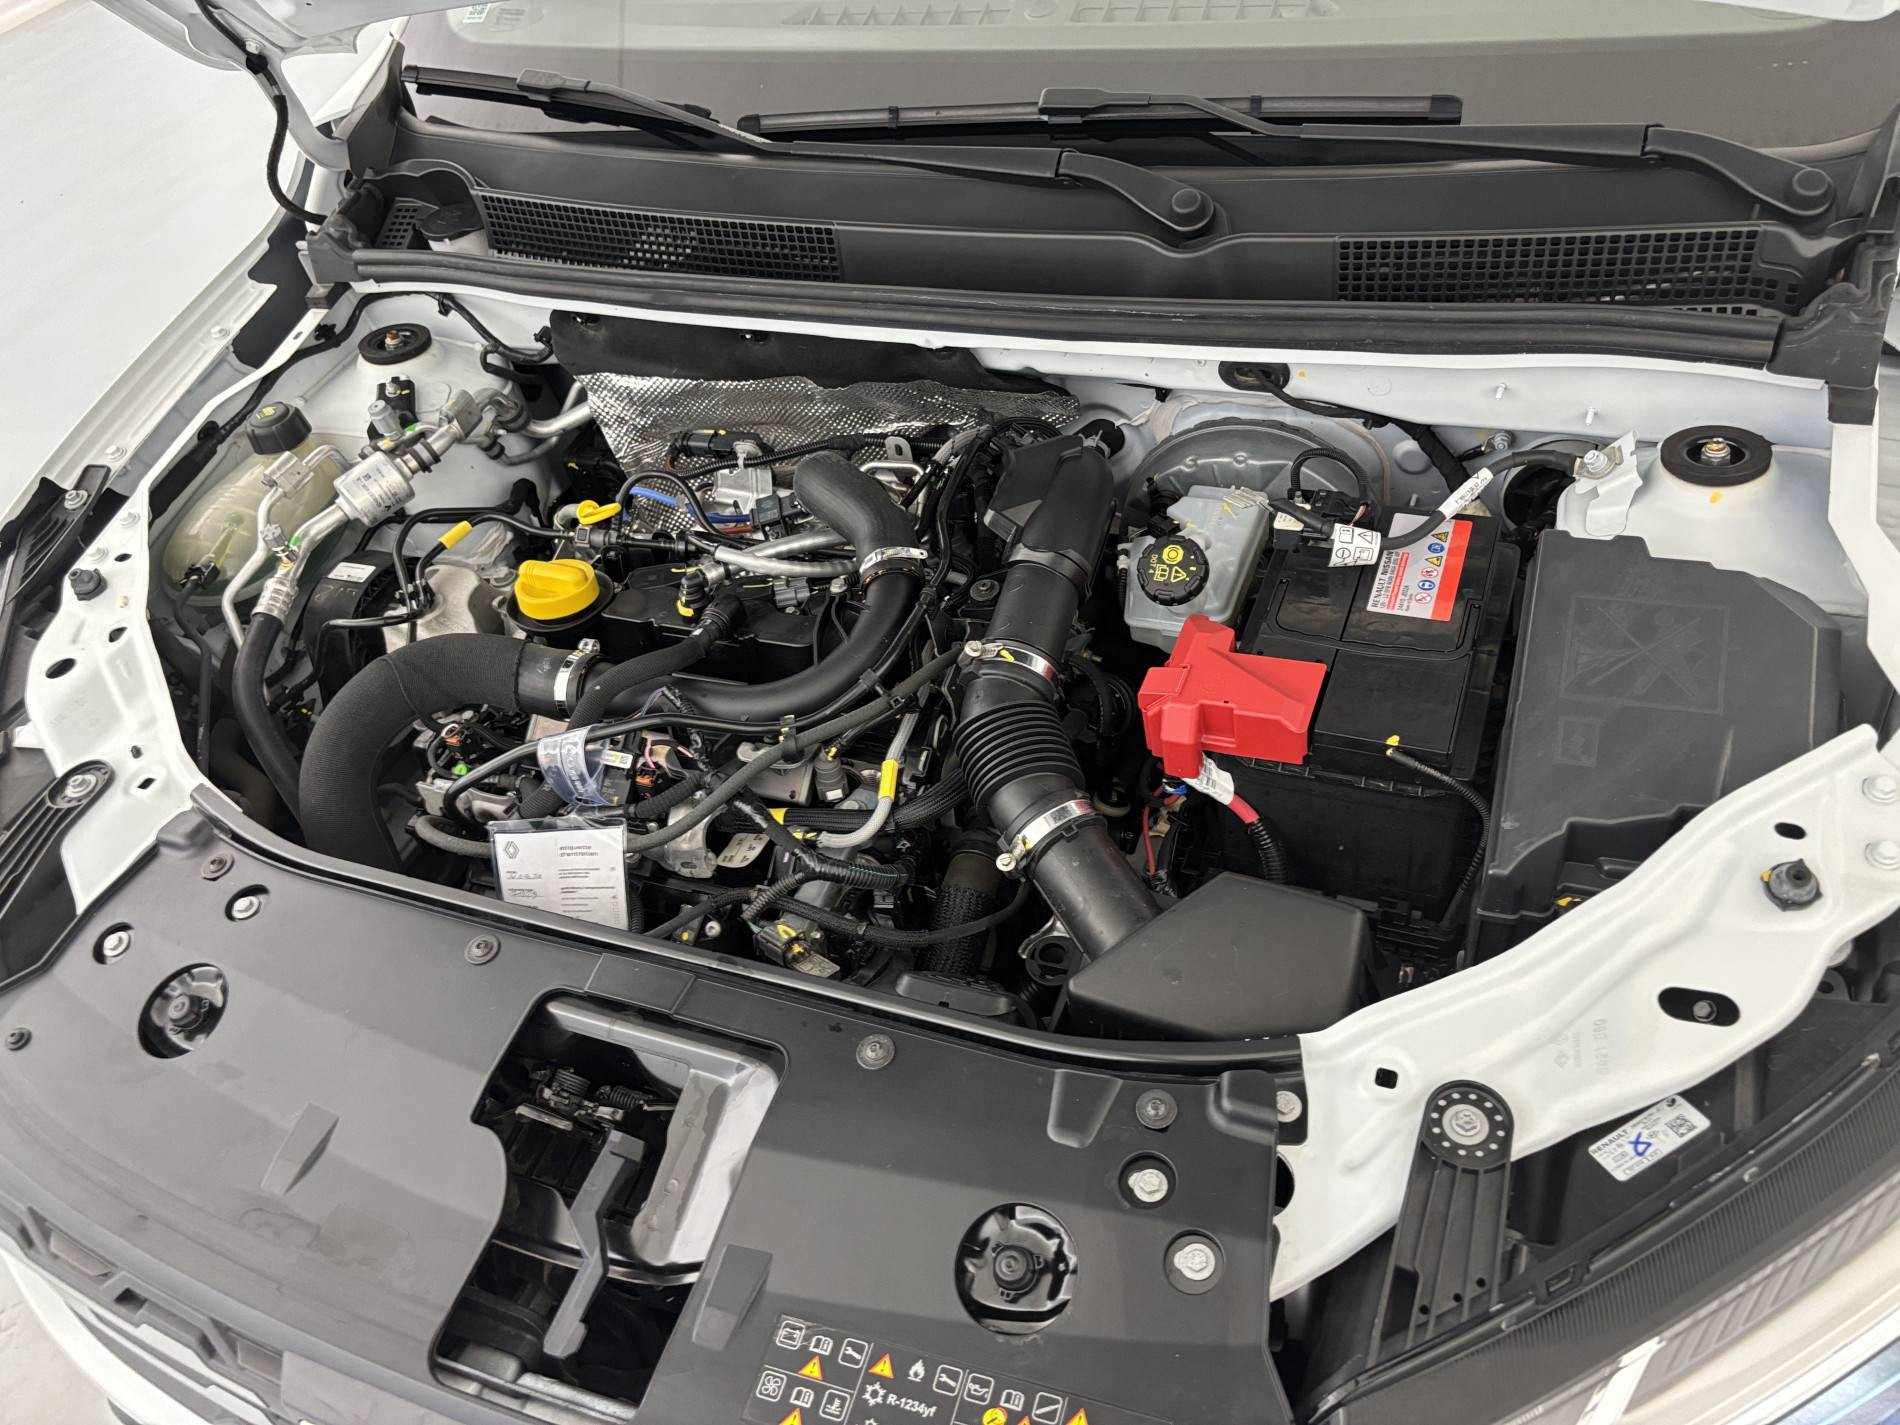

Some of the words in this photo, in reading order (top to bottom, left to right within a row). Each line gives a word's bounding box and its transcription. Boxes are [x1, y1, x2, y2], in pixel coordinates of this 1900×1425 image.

[1150, 554, 1158, 567] DOT
[1371, 578, 1385, 608] RENAULT
[1381, 551, 1394, 576] NISSAN
[1591, 1129, 1628, 1155] RENAULT
[886, 1393, 938, 1418] R-1234yf
